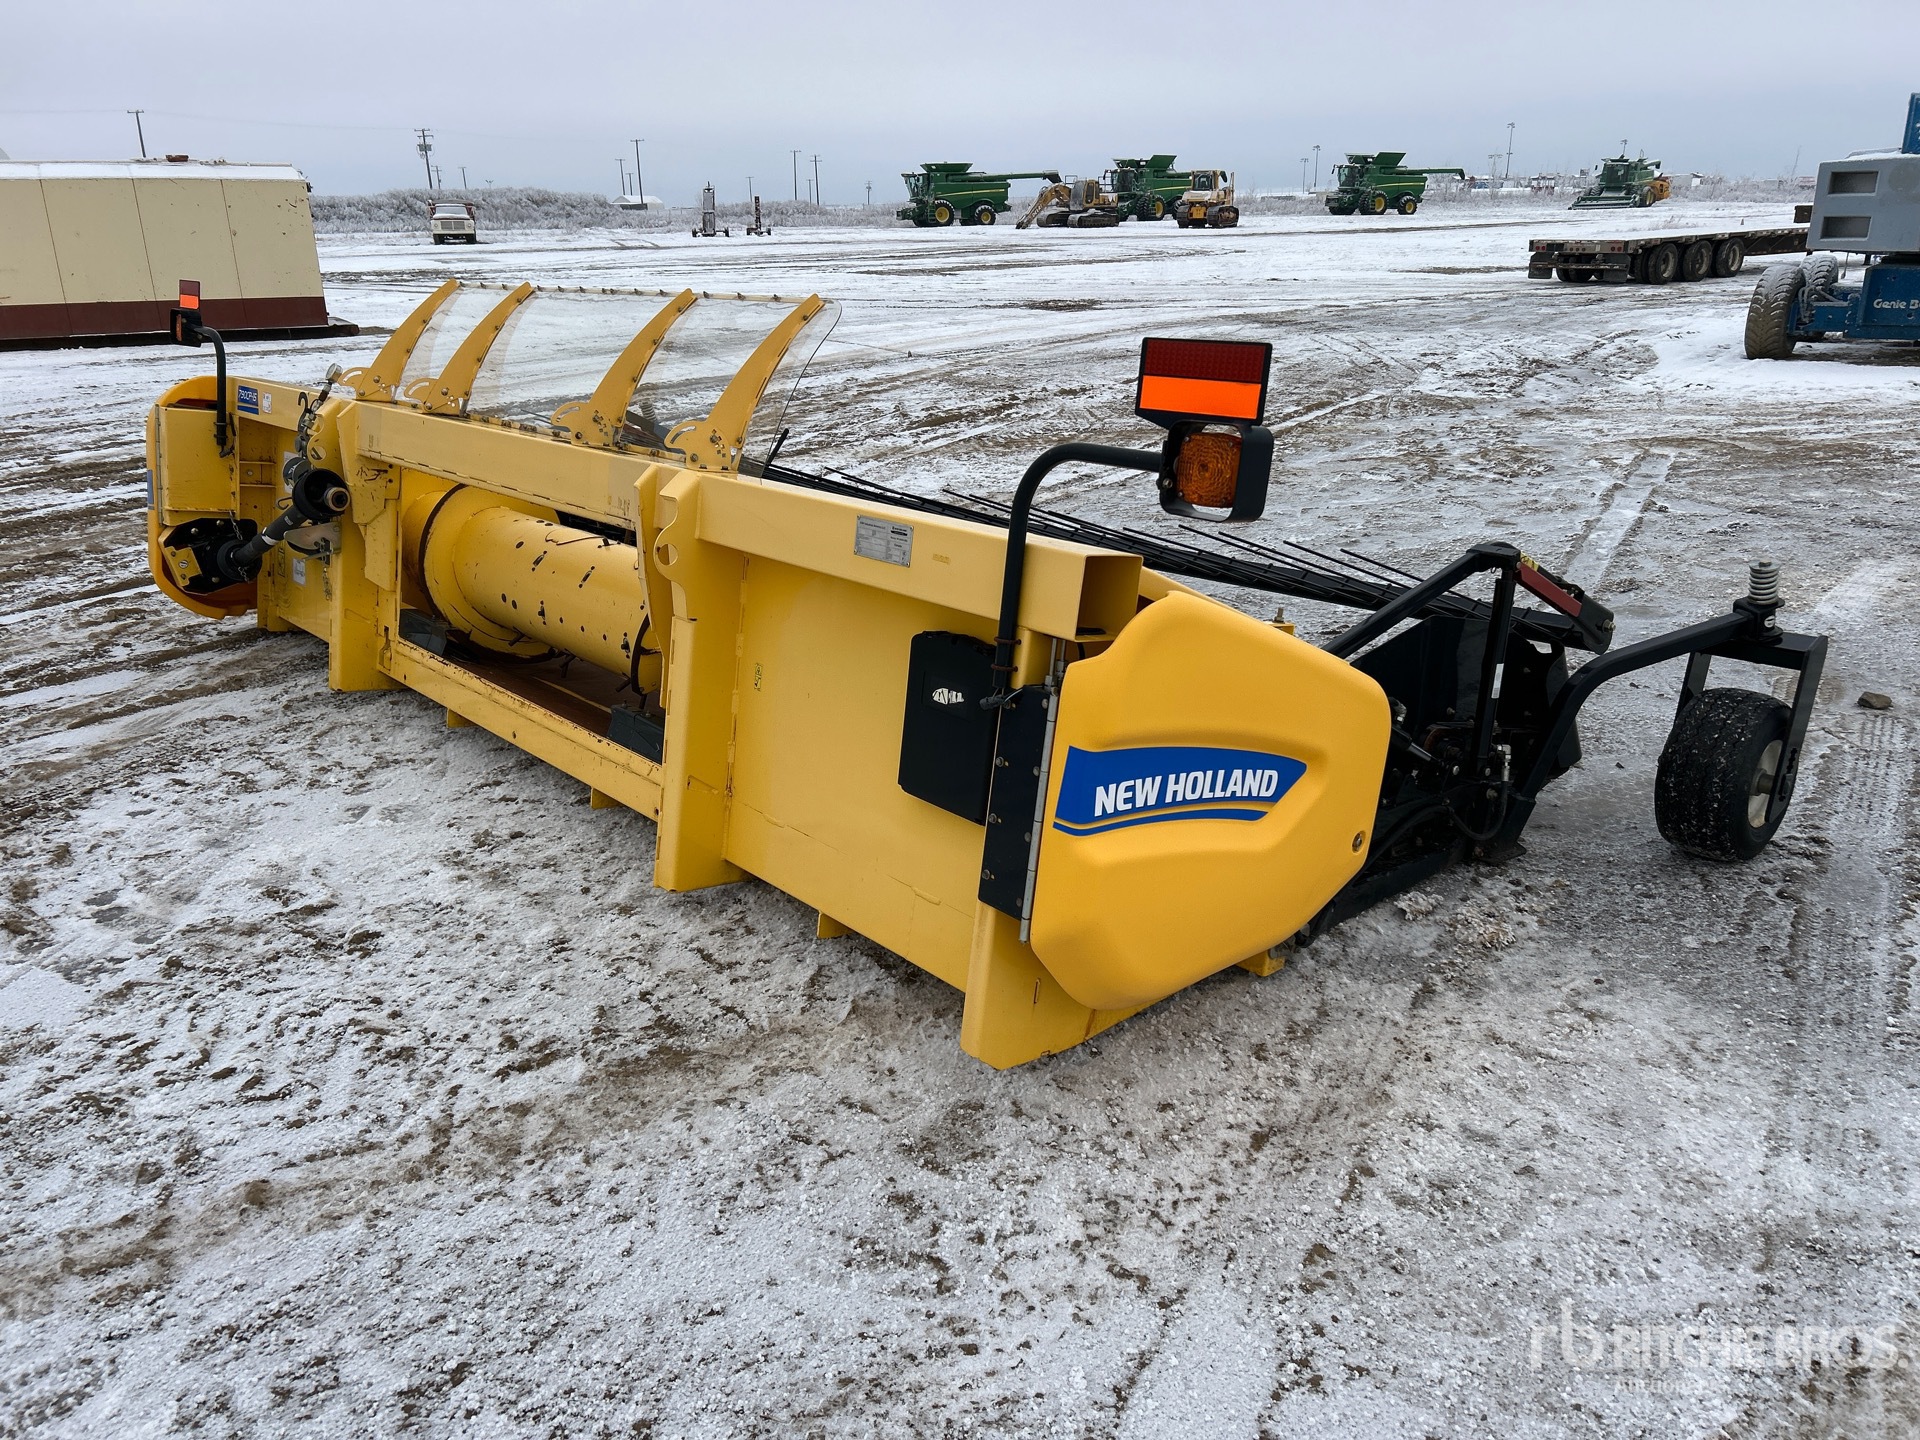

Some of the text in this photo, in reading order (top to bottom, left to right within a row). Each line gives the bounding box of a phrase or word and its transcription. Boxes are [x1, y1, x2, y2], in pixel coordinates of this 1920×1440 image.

[1873, 298, 1920, 309] Genie B
[1094, 769, 1278, 817] NEW HOLLAND
